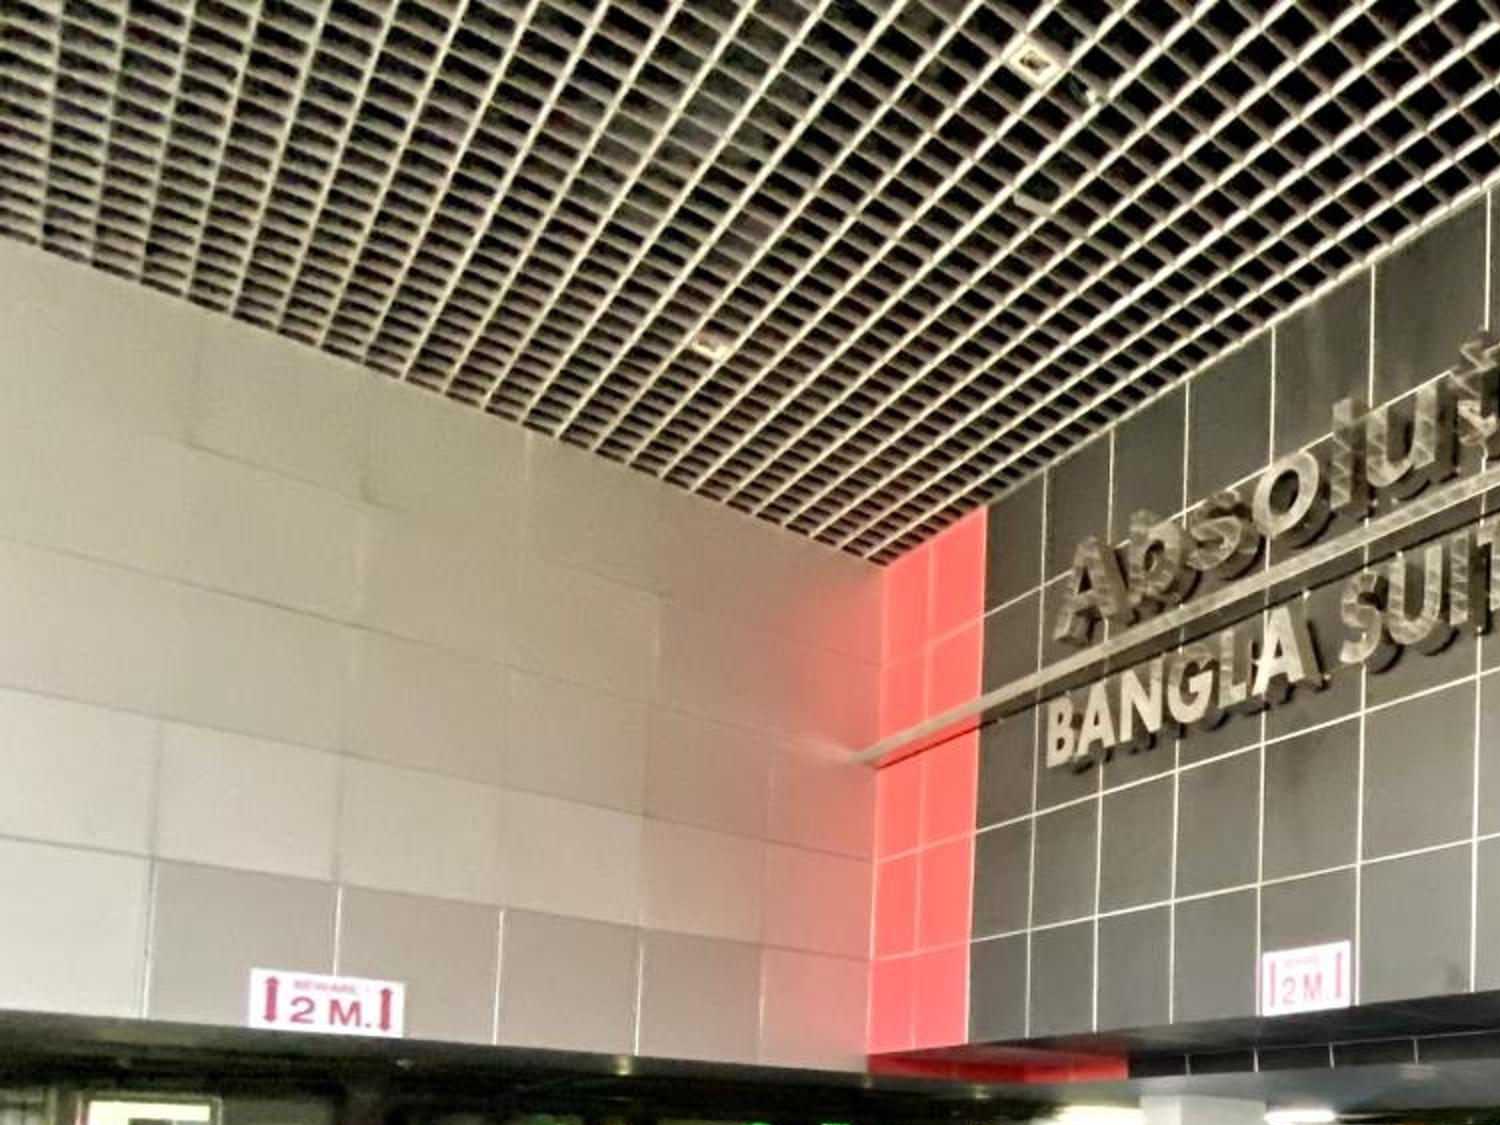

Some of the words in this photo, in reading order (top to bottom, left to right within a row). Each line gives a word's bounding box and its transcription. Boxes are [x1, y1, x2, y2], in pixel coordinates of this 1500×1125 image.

[1046, 604, 1316, 769] BANGLA
[1282, 976, 1296, 1005] 2
[289, 996, 316, 1025] 2
[329, 999, 371, 1028] M.
